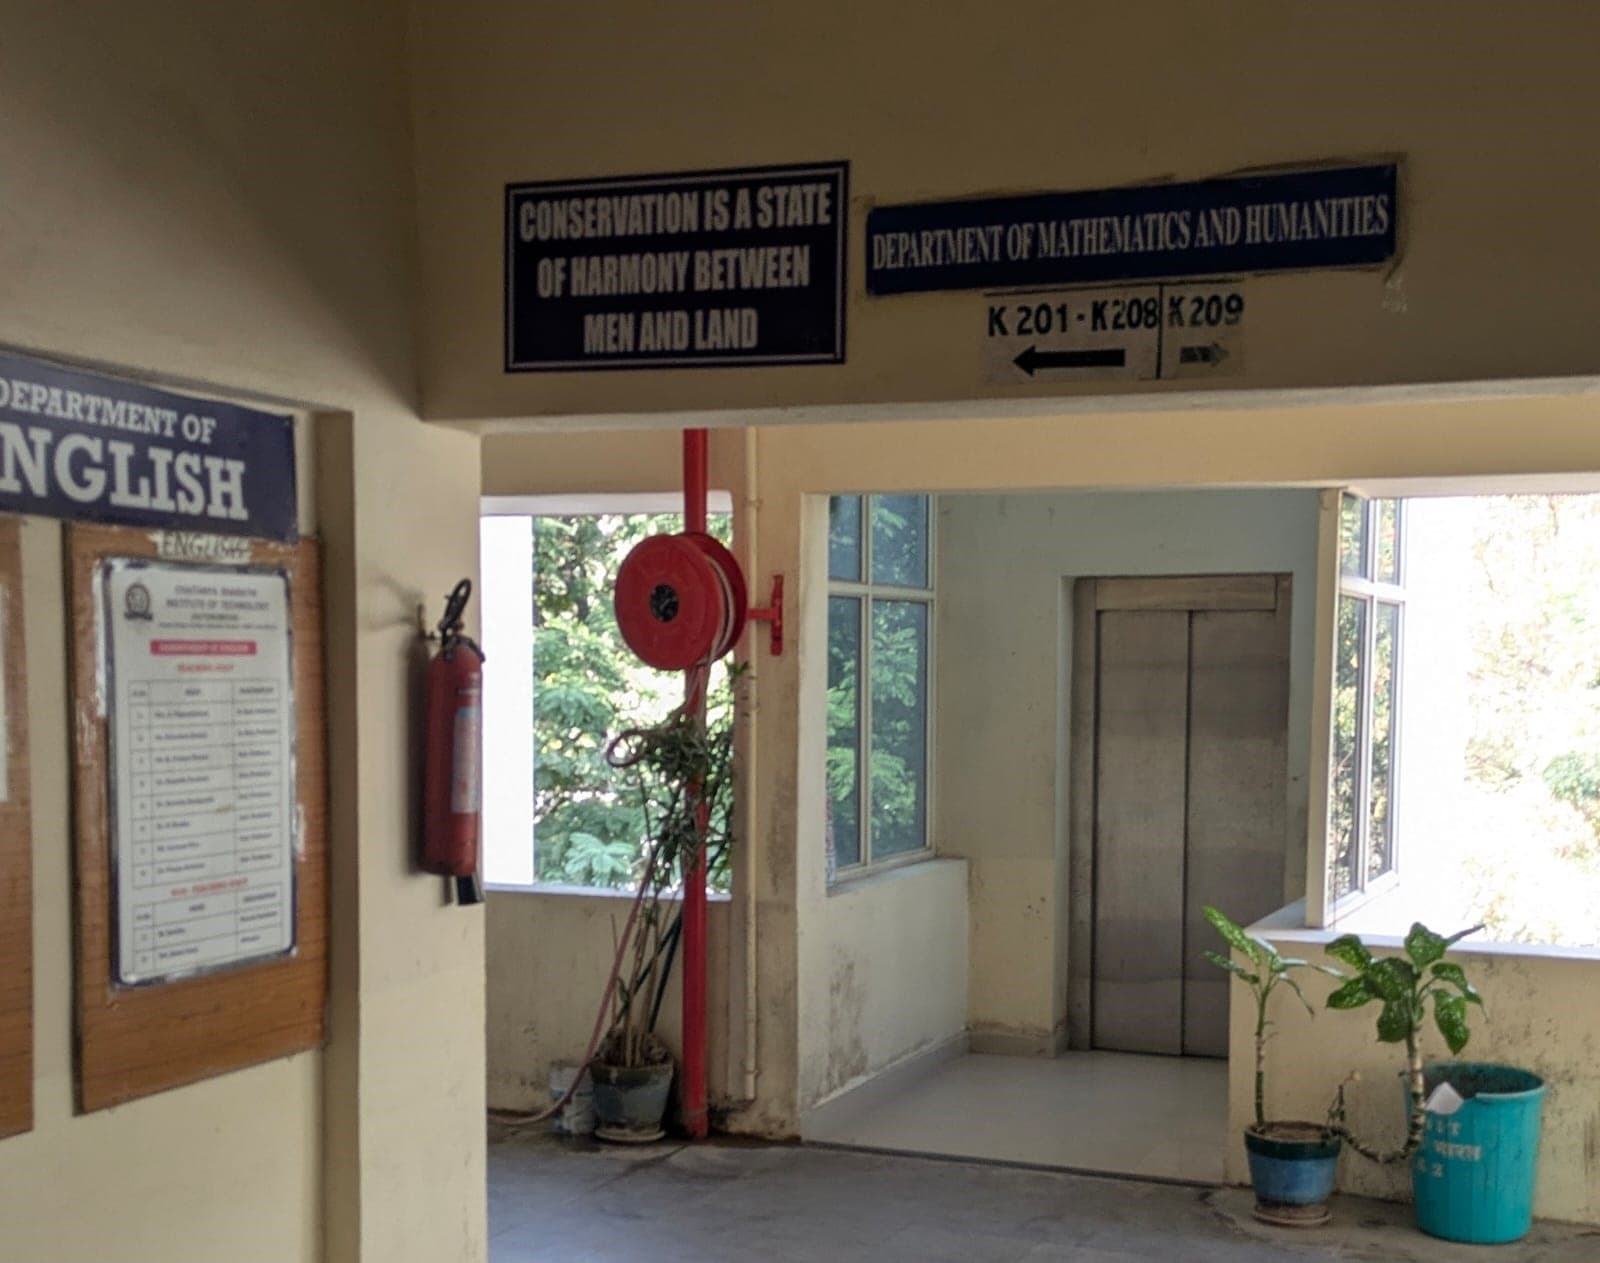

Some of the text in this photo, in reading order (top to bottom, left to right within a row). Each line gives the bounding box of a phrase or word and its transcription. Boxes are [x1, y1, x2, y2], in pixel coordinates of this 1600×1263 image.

[520, 183, 831, 242] CONSERVATION IS A STATE
[872, 194, 1389, 270] DEPARTMENT OF MATHEMATICS AND HUMANITIES
[538, 245, 811, 298] OF HARMONY BETWEEN
[584, 308, 758, 354] MEN AND LAND
[181, 414, 217, 444] OF
